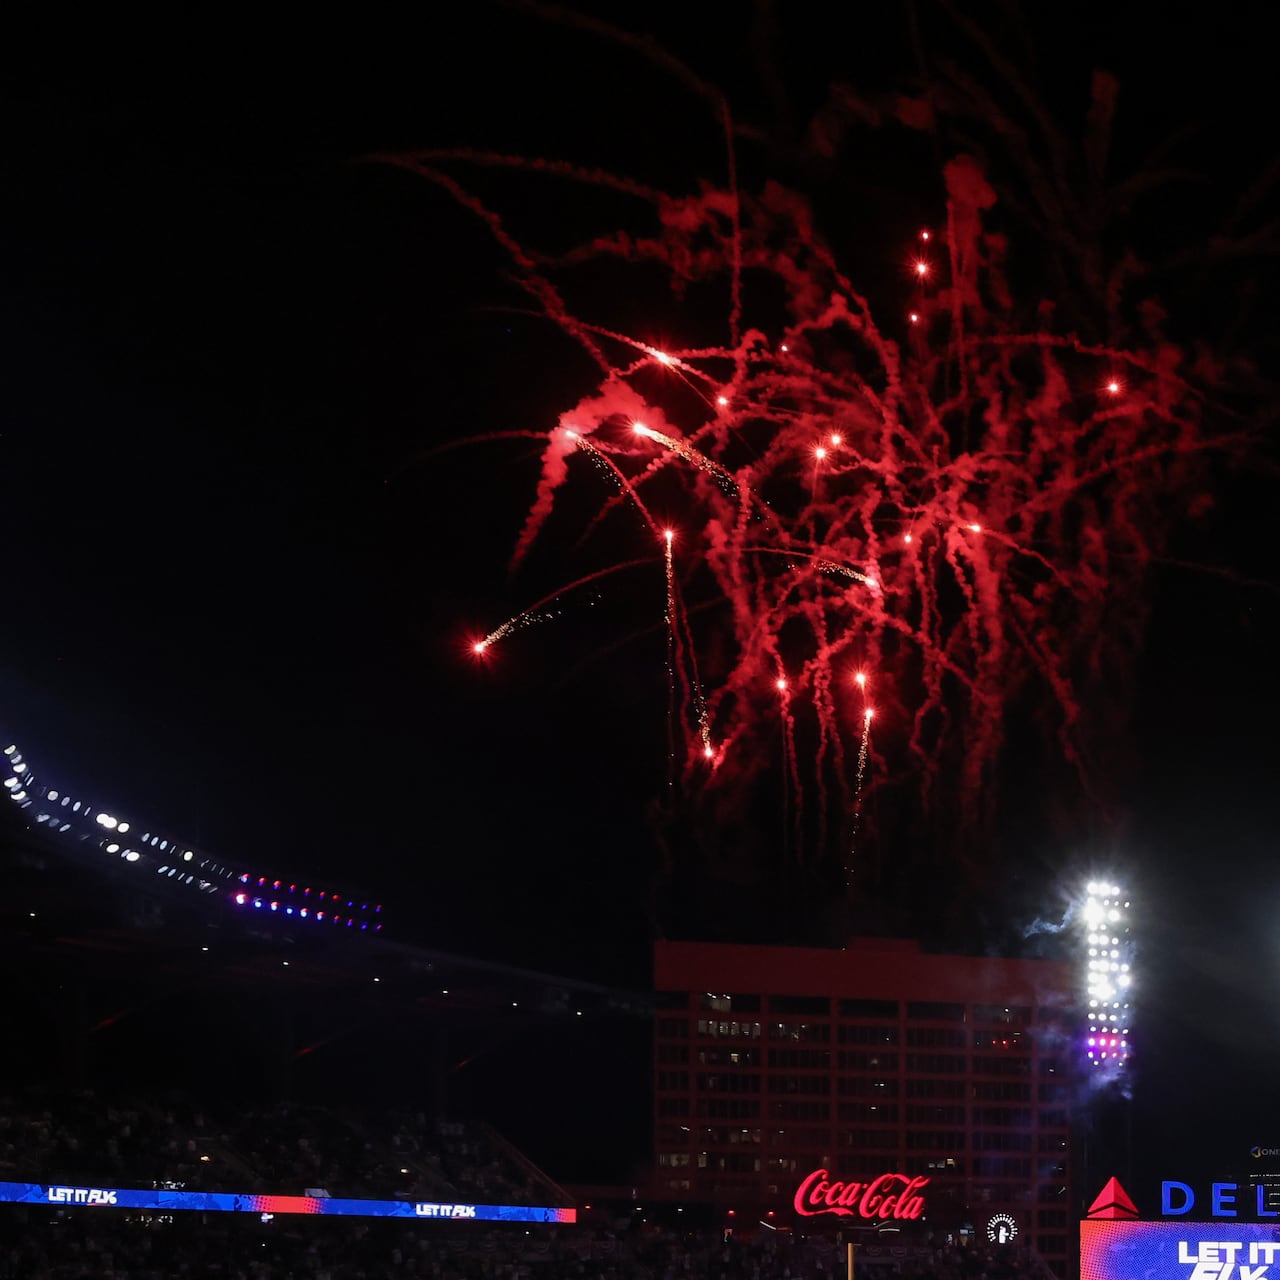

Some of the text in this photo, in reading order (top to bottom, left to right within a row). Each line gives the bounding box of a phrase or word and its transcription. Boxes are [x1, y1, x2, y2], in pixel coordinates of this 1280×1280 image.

[48, 1188, 89, 1202] LET IT
[794, 1168, 931, 1219] Coca-Cola
[416, 1203, 452, 1217] LET IT
[1178, 1241, 1280, 1264] LET IT
